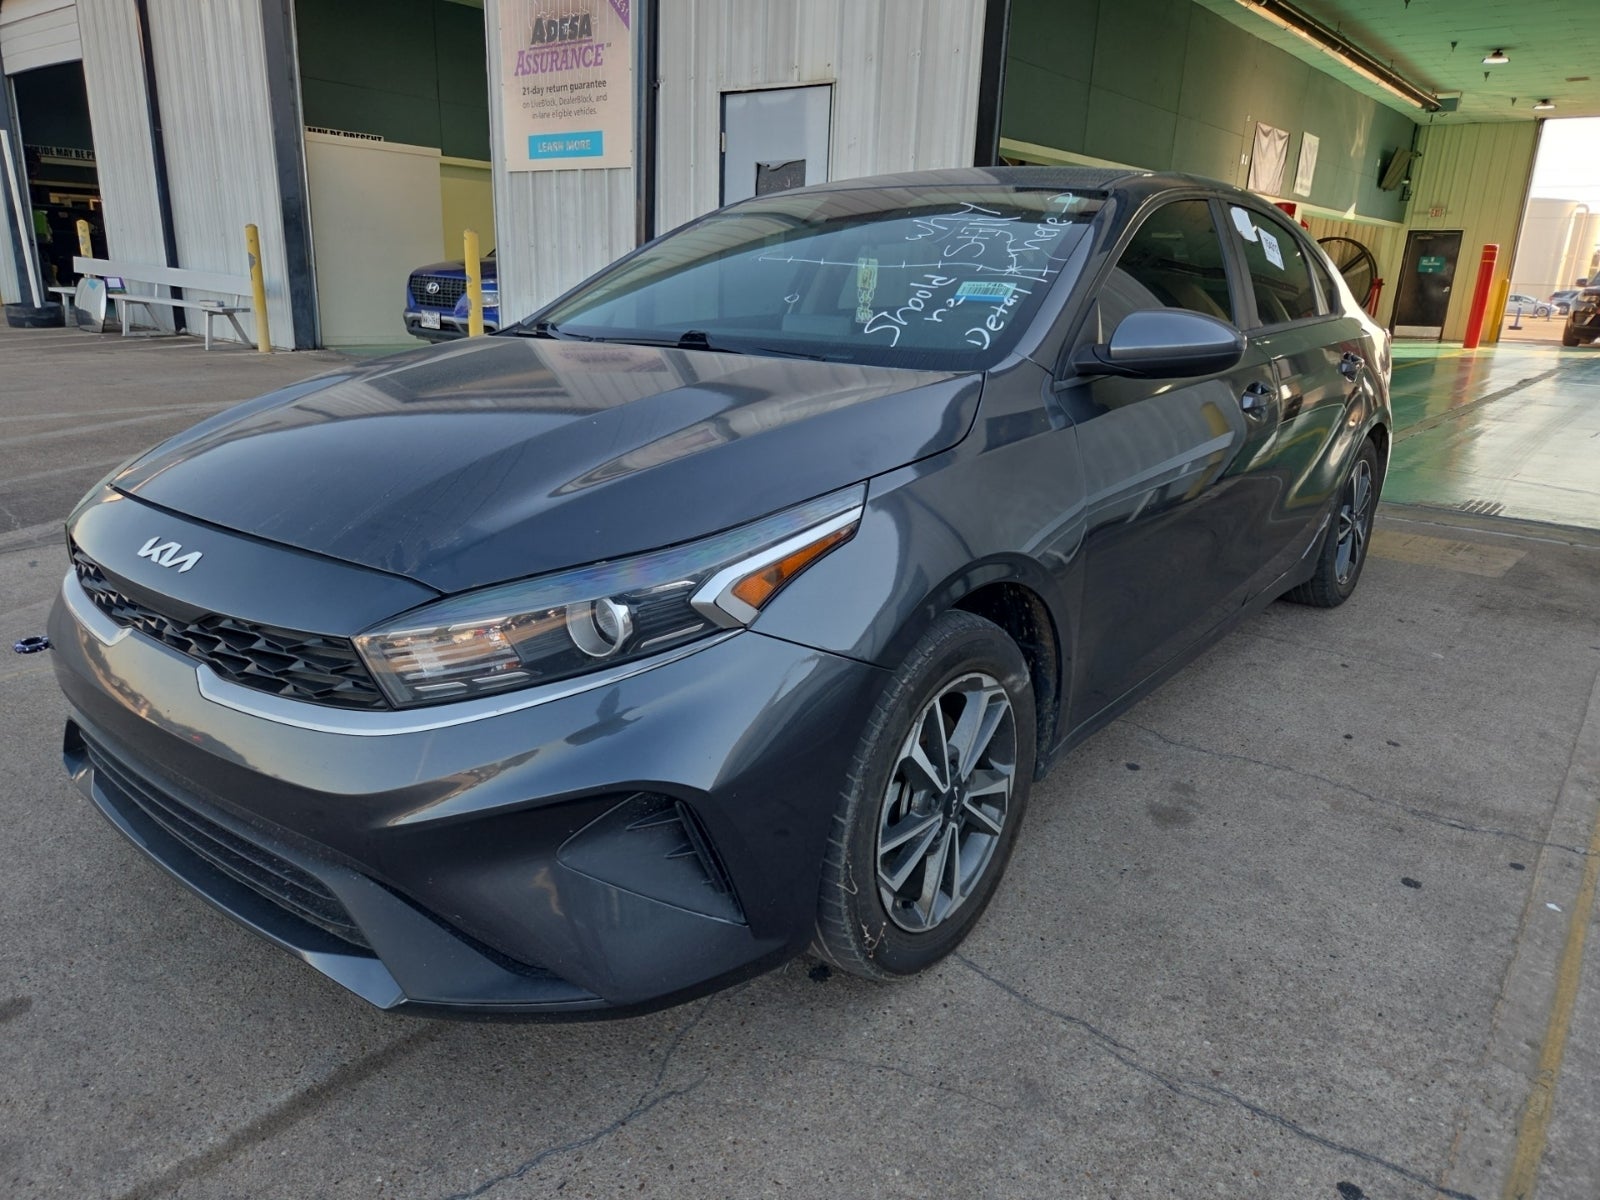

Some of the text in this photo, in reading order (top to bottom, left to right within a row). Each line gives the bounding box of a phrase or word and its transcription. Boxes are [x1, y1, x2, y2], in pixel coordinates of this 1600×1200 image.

[531, 13, 592, 44] ADESA
[514, 43, 605, 76] ASSURANCE
[522, 80, 607, 96] 21-day return guarantee
[596, 92, 607, 102] and
[551, 108, 573, 120] eligible
[538, 139, 592, 153] LEARN MORE
[137, 536, 203, 574] KIA
